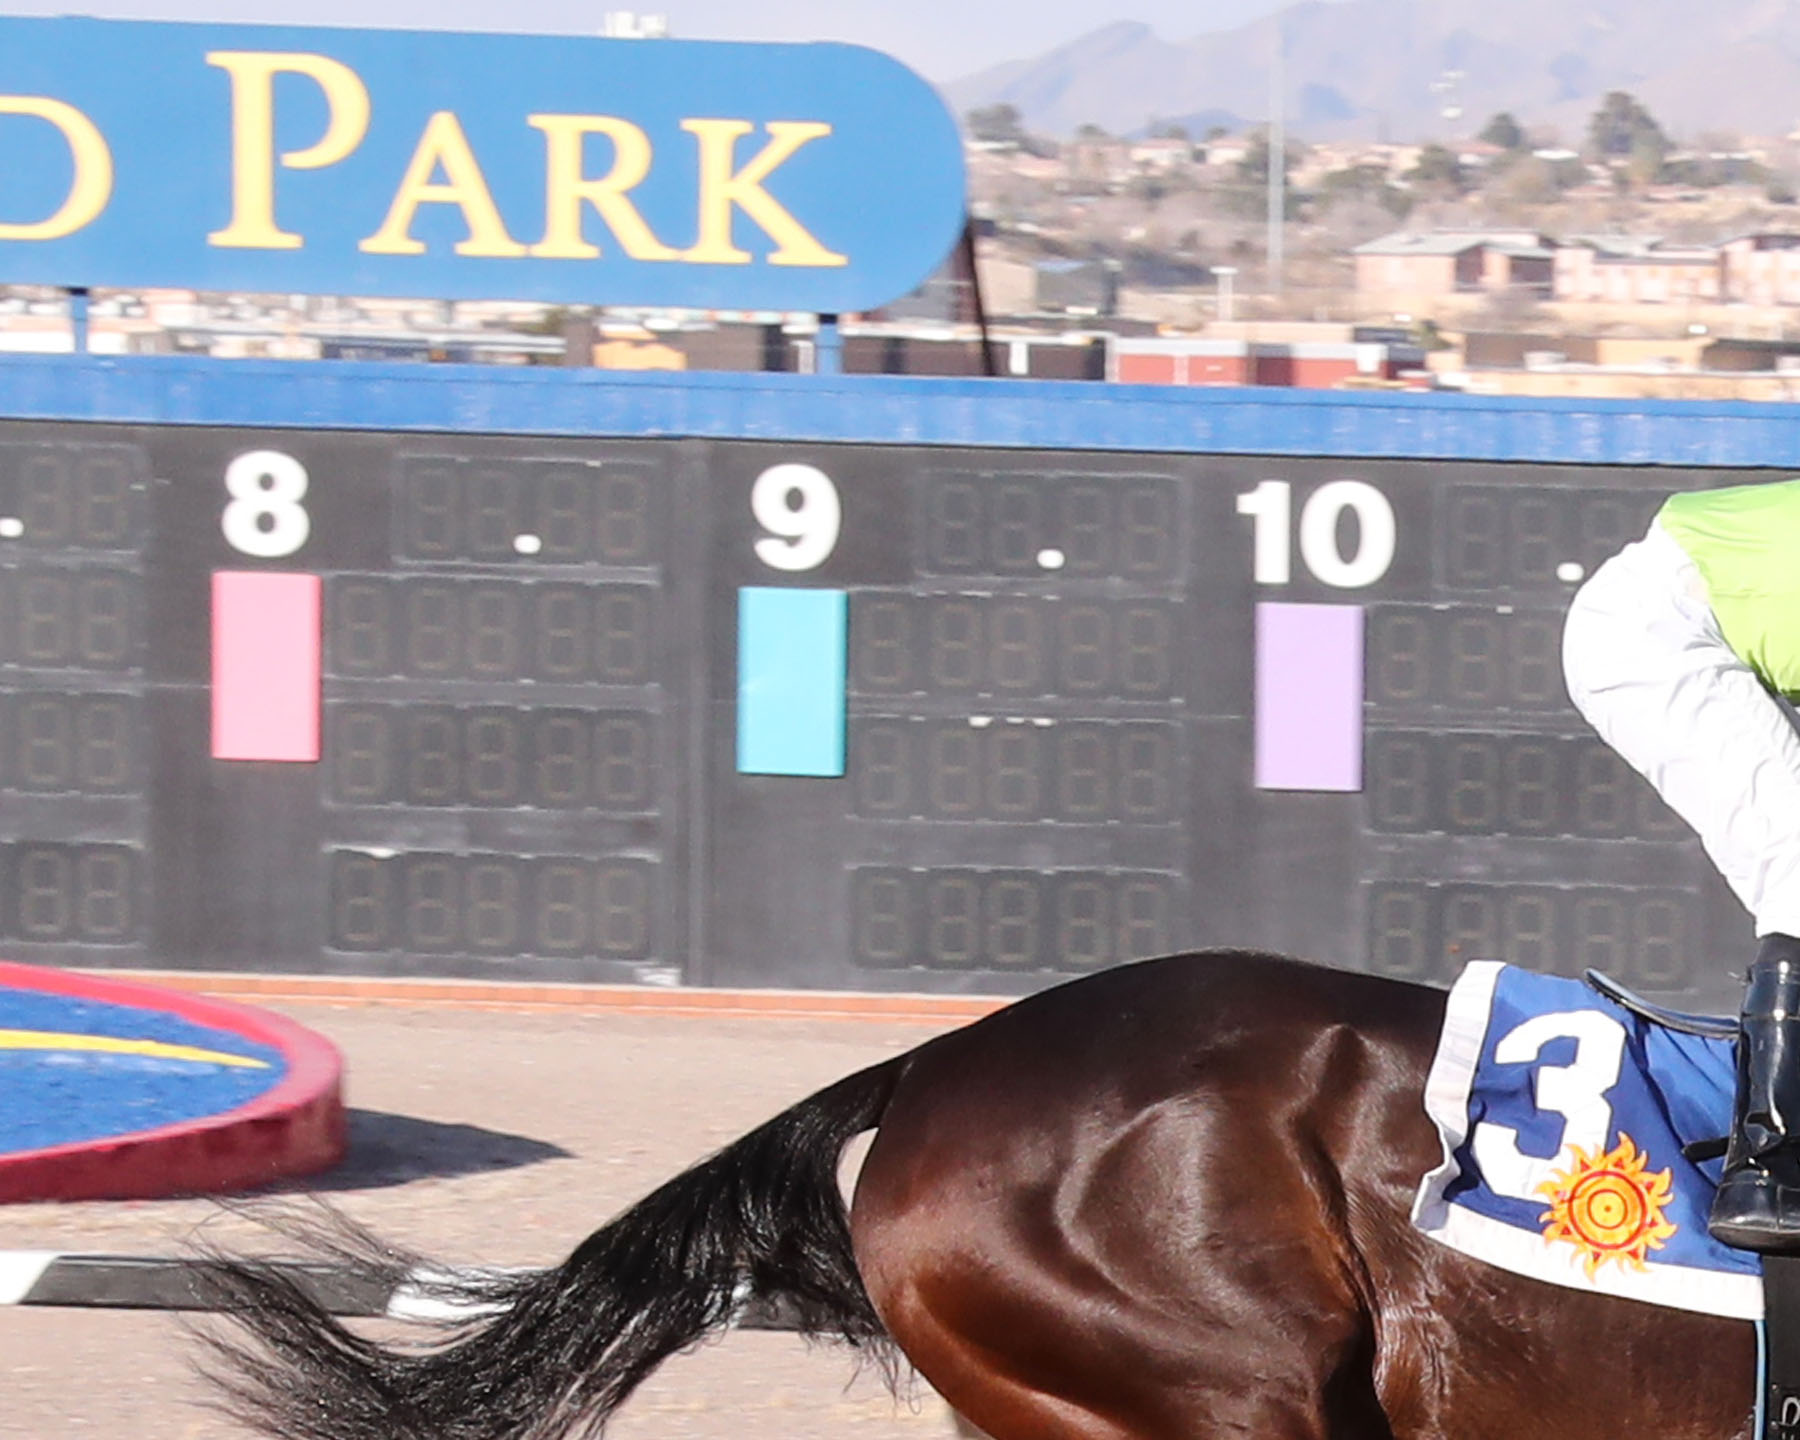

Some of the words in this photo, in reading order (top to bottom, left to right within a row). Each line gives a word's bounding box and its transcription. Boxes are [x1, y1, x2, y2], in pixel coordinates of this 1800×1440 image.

[206, 51, 849, 268] PARK
[222, 450, 310, 557] 8
[752, 464, 842, 571] 9
[1237, 480, 1397, 589] 10
[1474, 1010, 1627, 1201] 3
